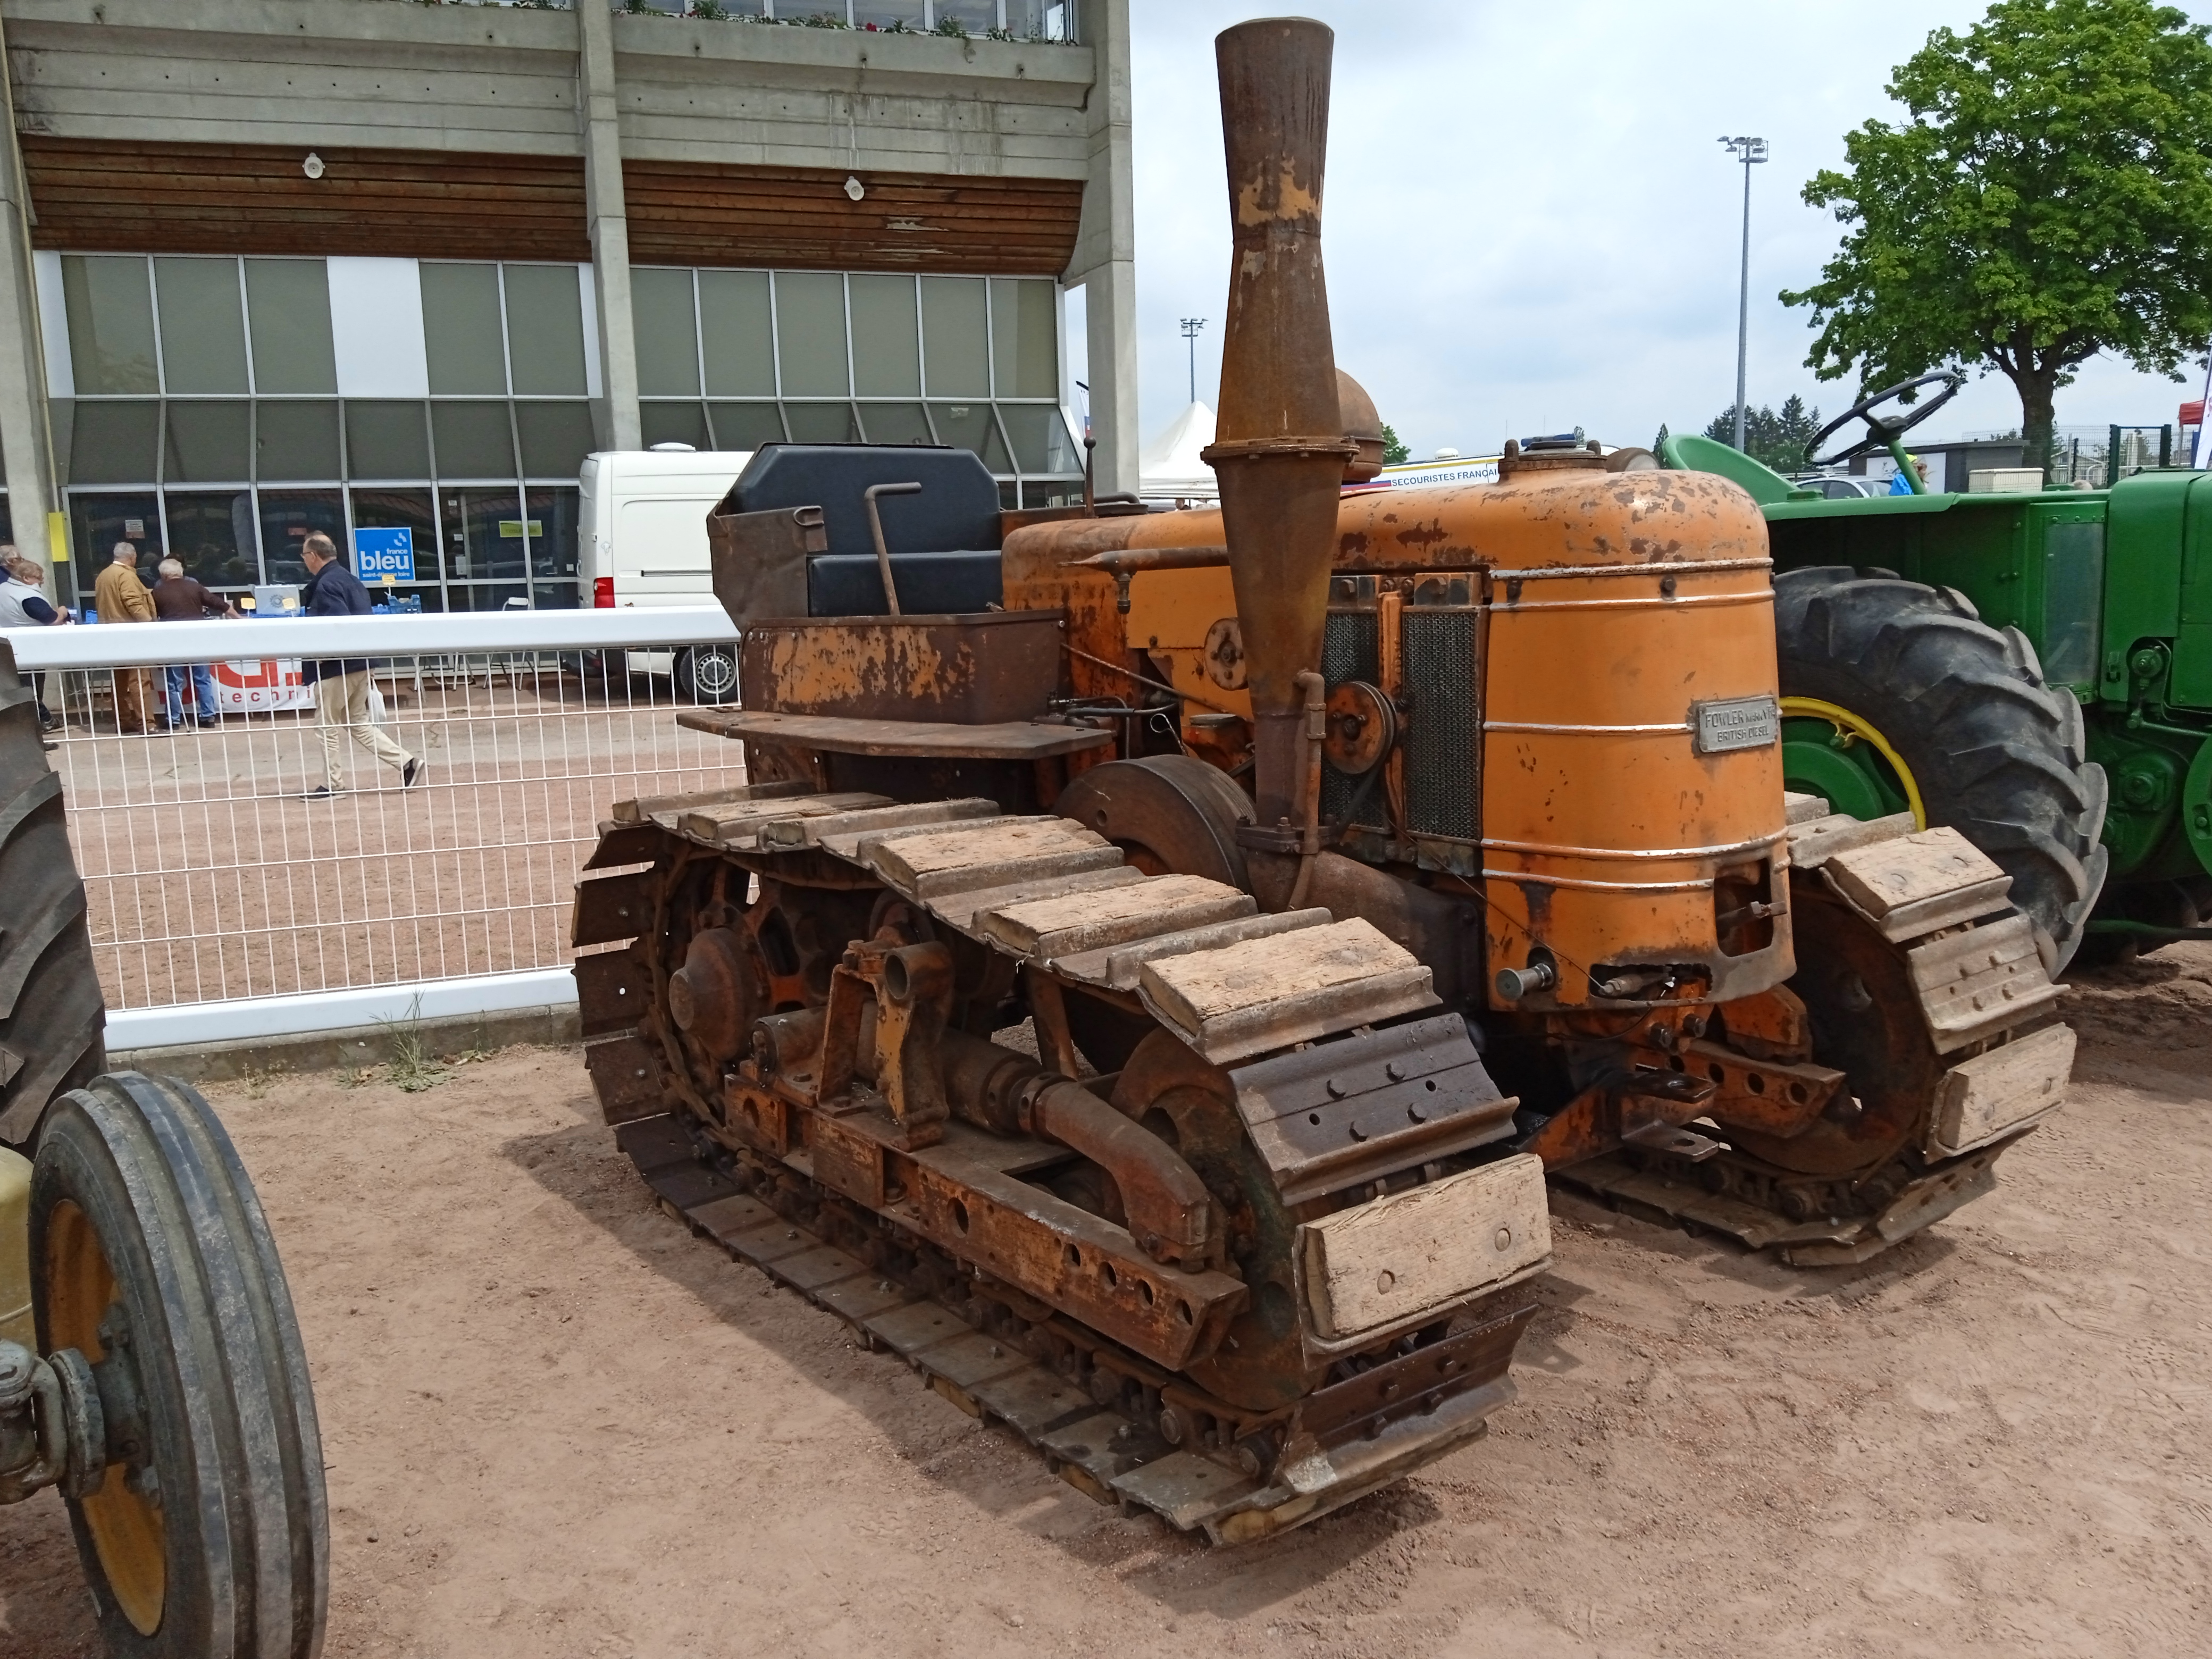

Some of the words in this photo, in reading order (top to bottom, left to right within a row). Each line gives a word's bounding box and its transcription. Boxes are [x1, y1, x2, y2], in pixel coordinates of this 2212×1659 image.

[1392, 473, 1455, 487] SECOURISTES
[1457, 468, 1497, 480] FRANÇAI
[360, 550, 409, 571] bleu
[1705, 709, 1744, 728] FOWLER
[1717, 727, 1747, 742] BRITISH
[1748, 724, 1769, 738] DIESEL
